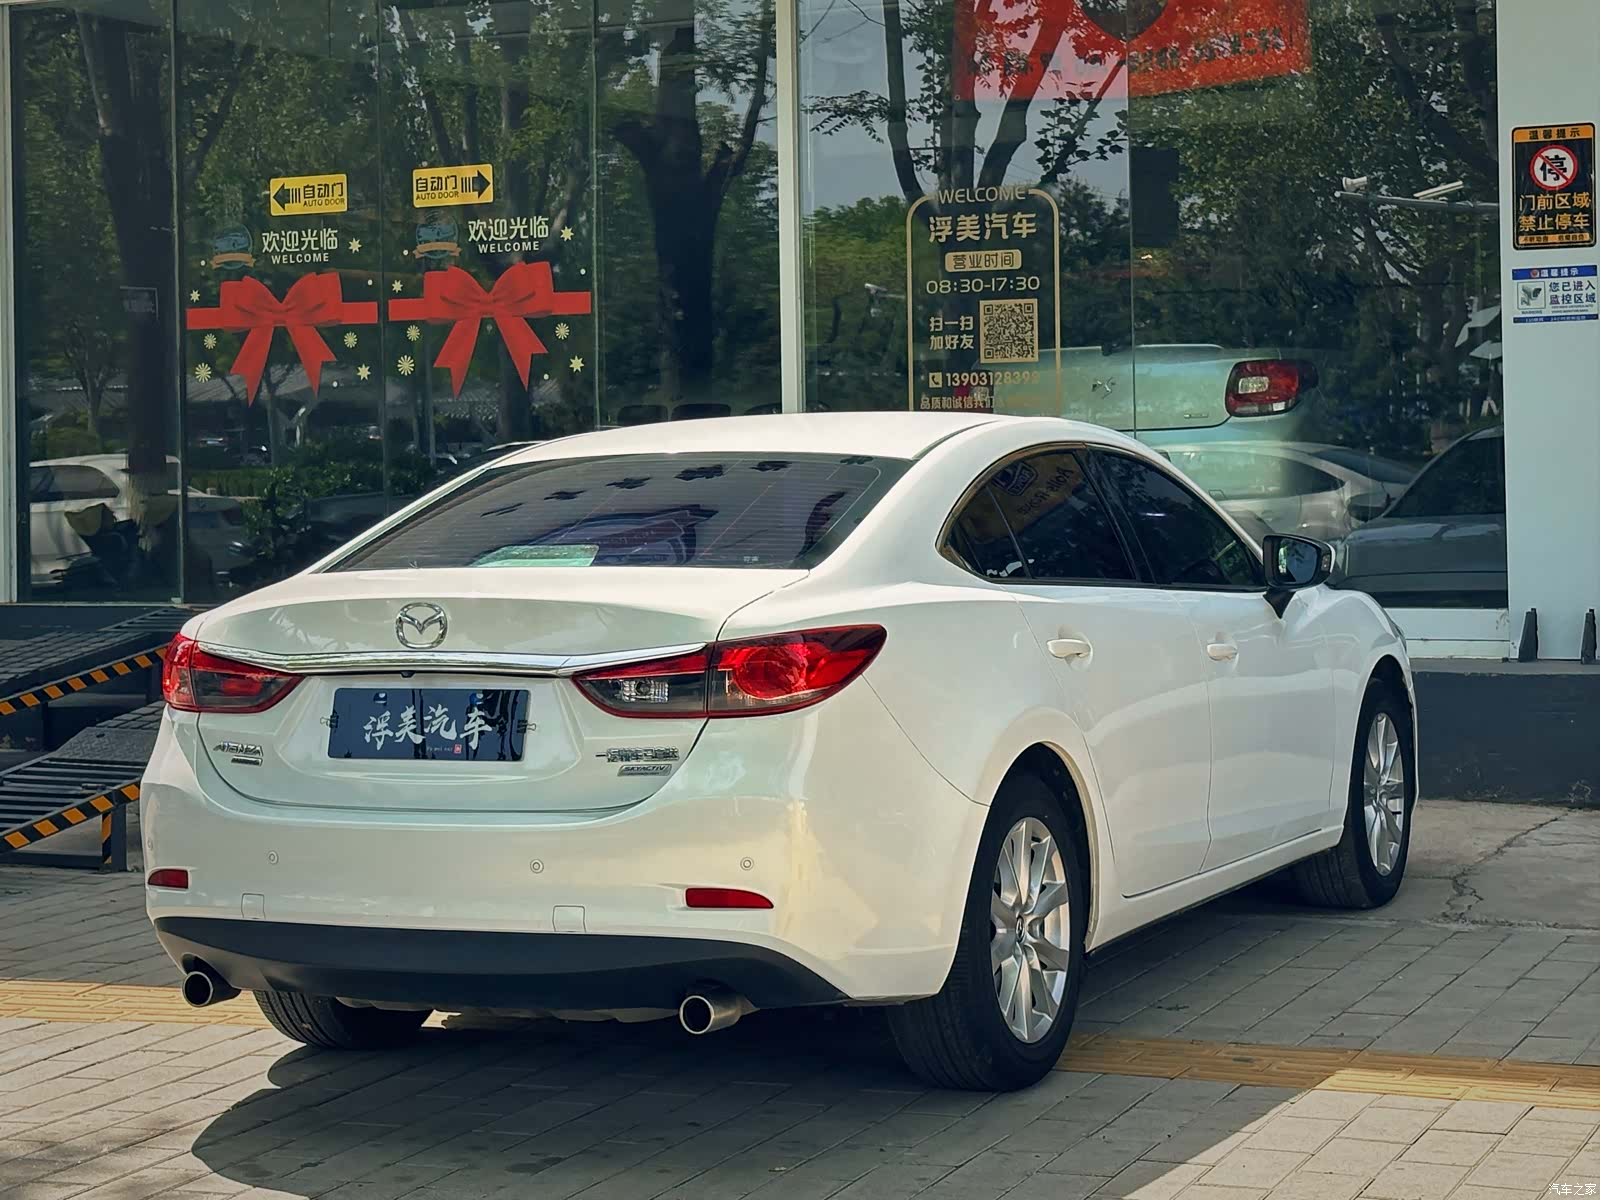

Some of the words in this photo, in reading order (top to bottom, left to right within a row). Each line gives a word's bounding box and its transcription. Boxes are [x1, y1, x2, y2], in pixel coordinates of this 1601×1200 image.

[1529, 127, 1580, 140] 温馨提示
[1540, 154, 1568, 182] 停
[303, 182, 344, 199] 自动门
[416, 175, 457, 192] 自动门
[303, 199, 323, 207] AUTO
[325, 198, 345, 206] DOOR
[438, 191, 459, 199] DOOR
[939, 186, 1026, 204] WELCOME
[1519, 192, 1591, 211] 门前区域
[468, 215, 549, 242] 欢迎光临
[928, 211, 1037, 243] 浮美汽车
[1518, 212, 1590, 231] 禁止停车
[262, 228, 338, 253] 欢迎光临
[479, 241, 540, 254] WELCOME
[271, 252, 329, 264] WELCOME
[952, 252, 1015, 269] 营业时间
[926, 276, 1040, 294] 08:30-17:30
[1549, 280, 1596, 292] 您已进入
[1549, 293, 1596, 305] 监控区域
[929, 315, 974, 332] 扫一扫
[929, 334, 974, 350] 加好友
[363, 704, 492, 751] 浮美汽车
